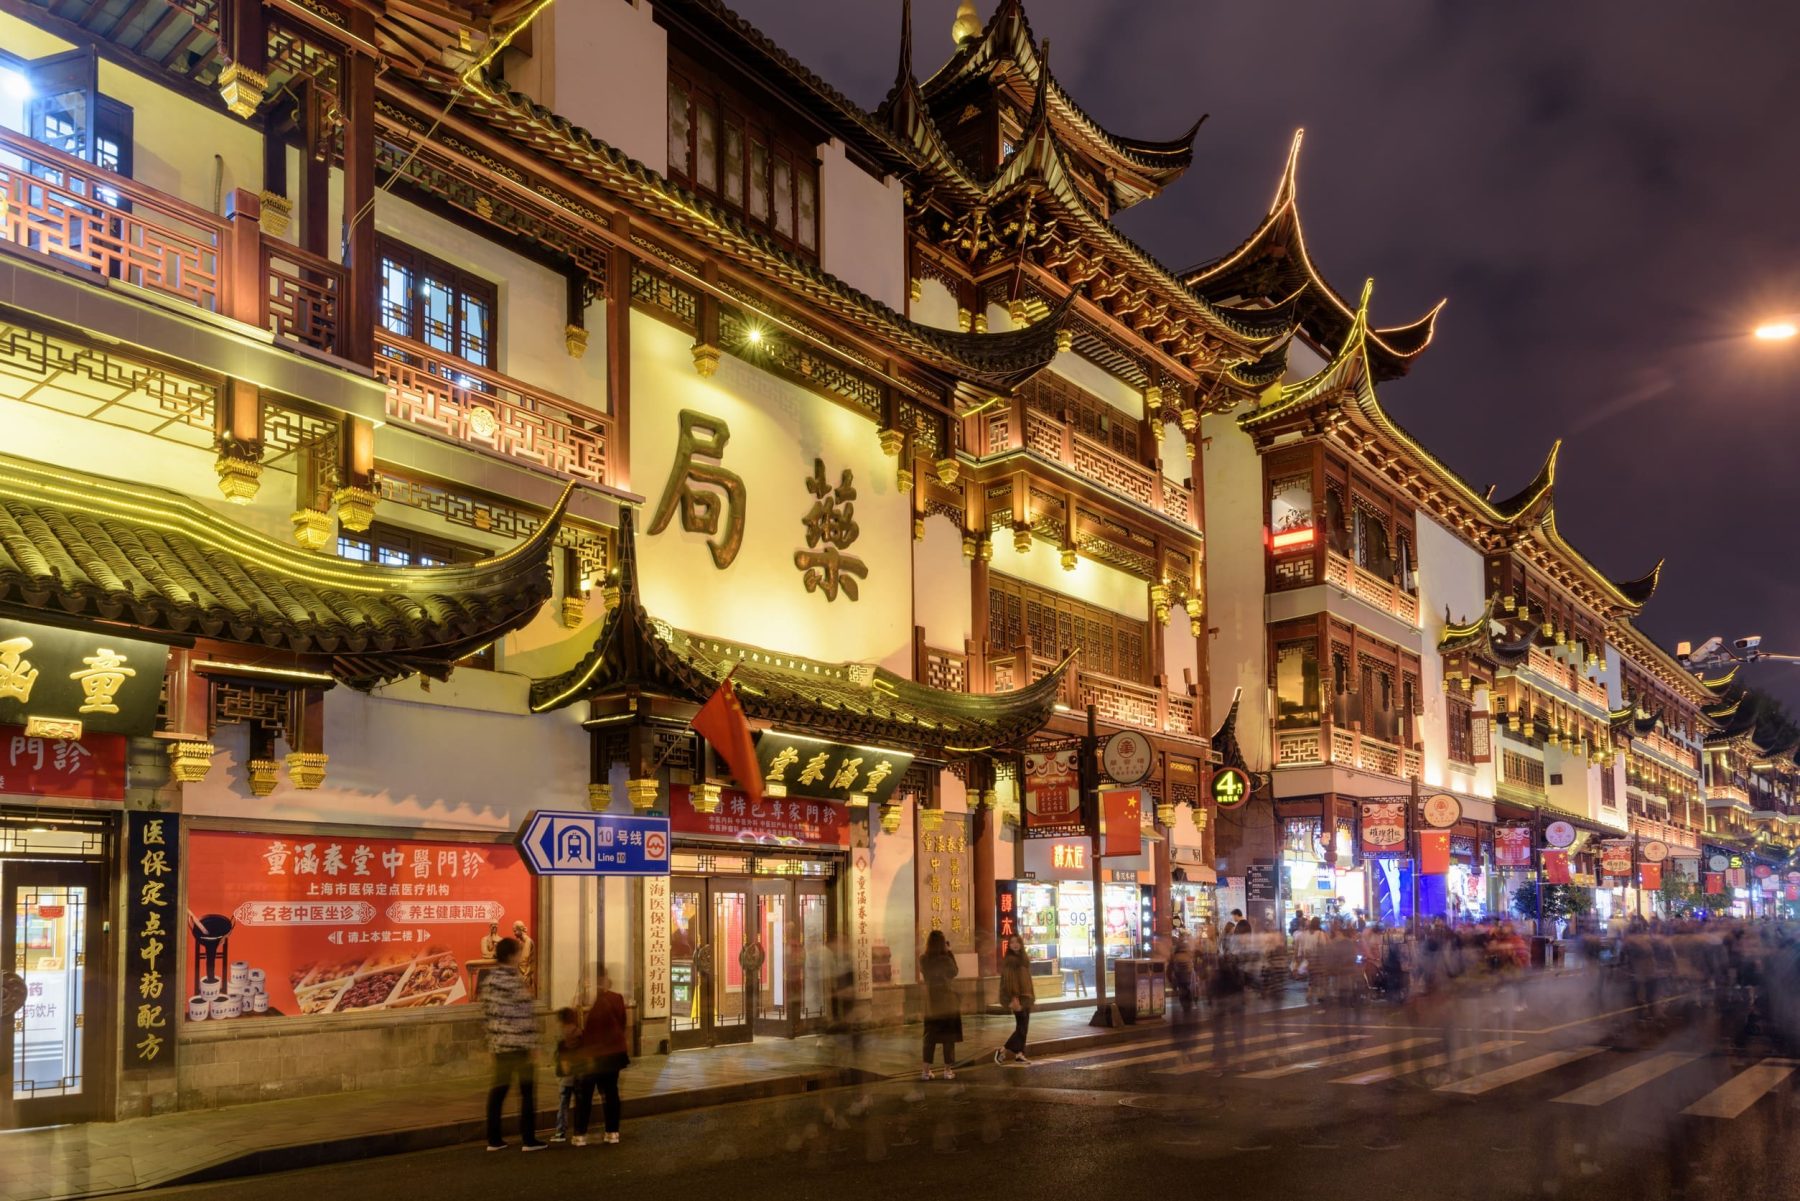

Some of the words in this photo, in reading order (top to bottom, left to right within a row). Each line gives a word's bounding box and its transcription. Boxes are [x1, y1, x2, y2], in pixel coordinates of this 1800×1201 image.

[262, 841, 485, 879] 童涵春堂中醫門診
[598, 853, 614, 862] Line
[306, 882, 450, 896] 上海市医保定点医疗机构
[261, 905, 354, 922] 名老中医坐诊
[409, 905, 486, 919] 养生健康调治
[137, 819, 172, 1061] 医保定点中药配方
[347, 931, 412, 943] 请上本堂二楼
